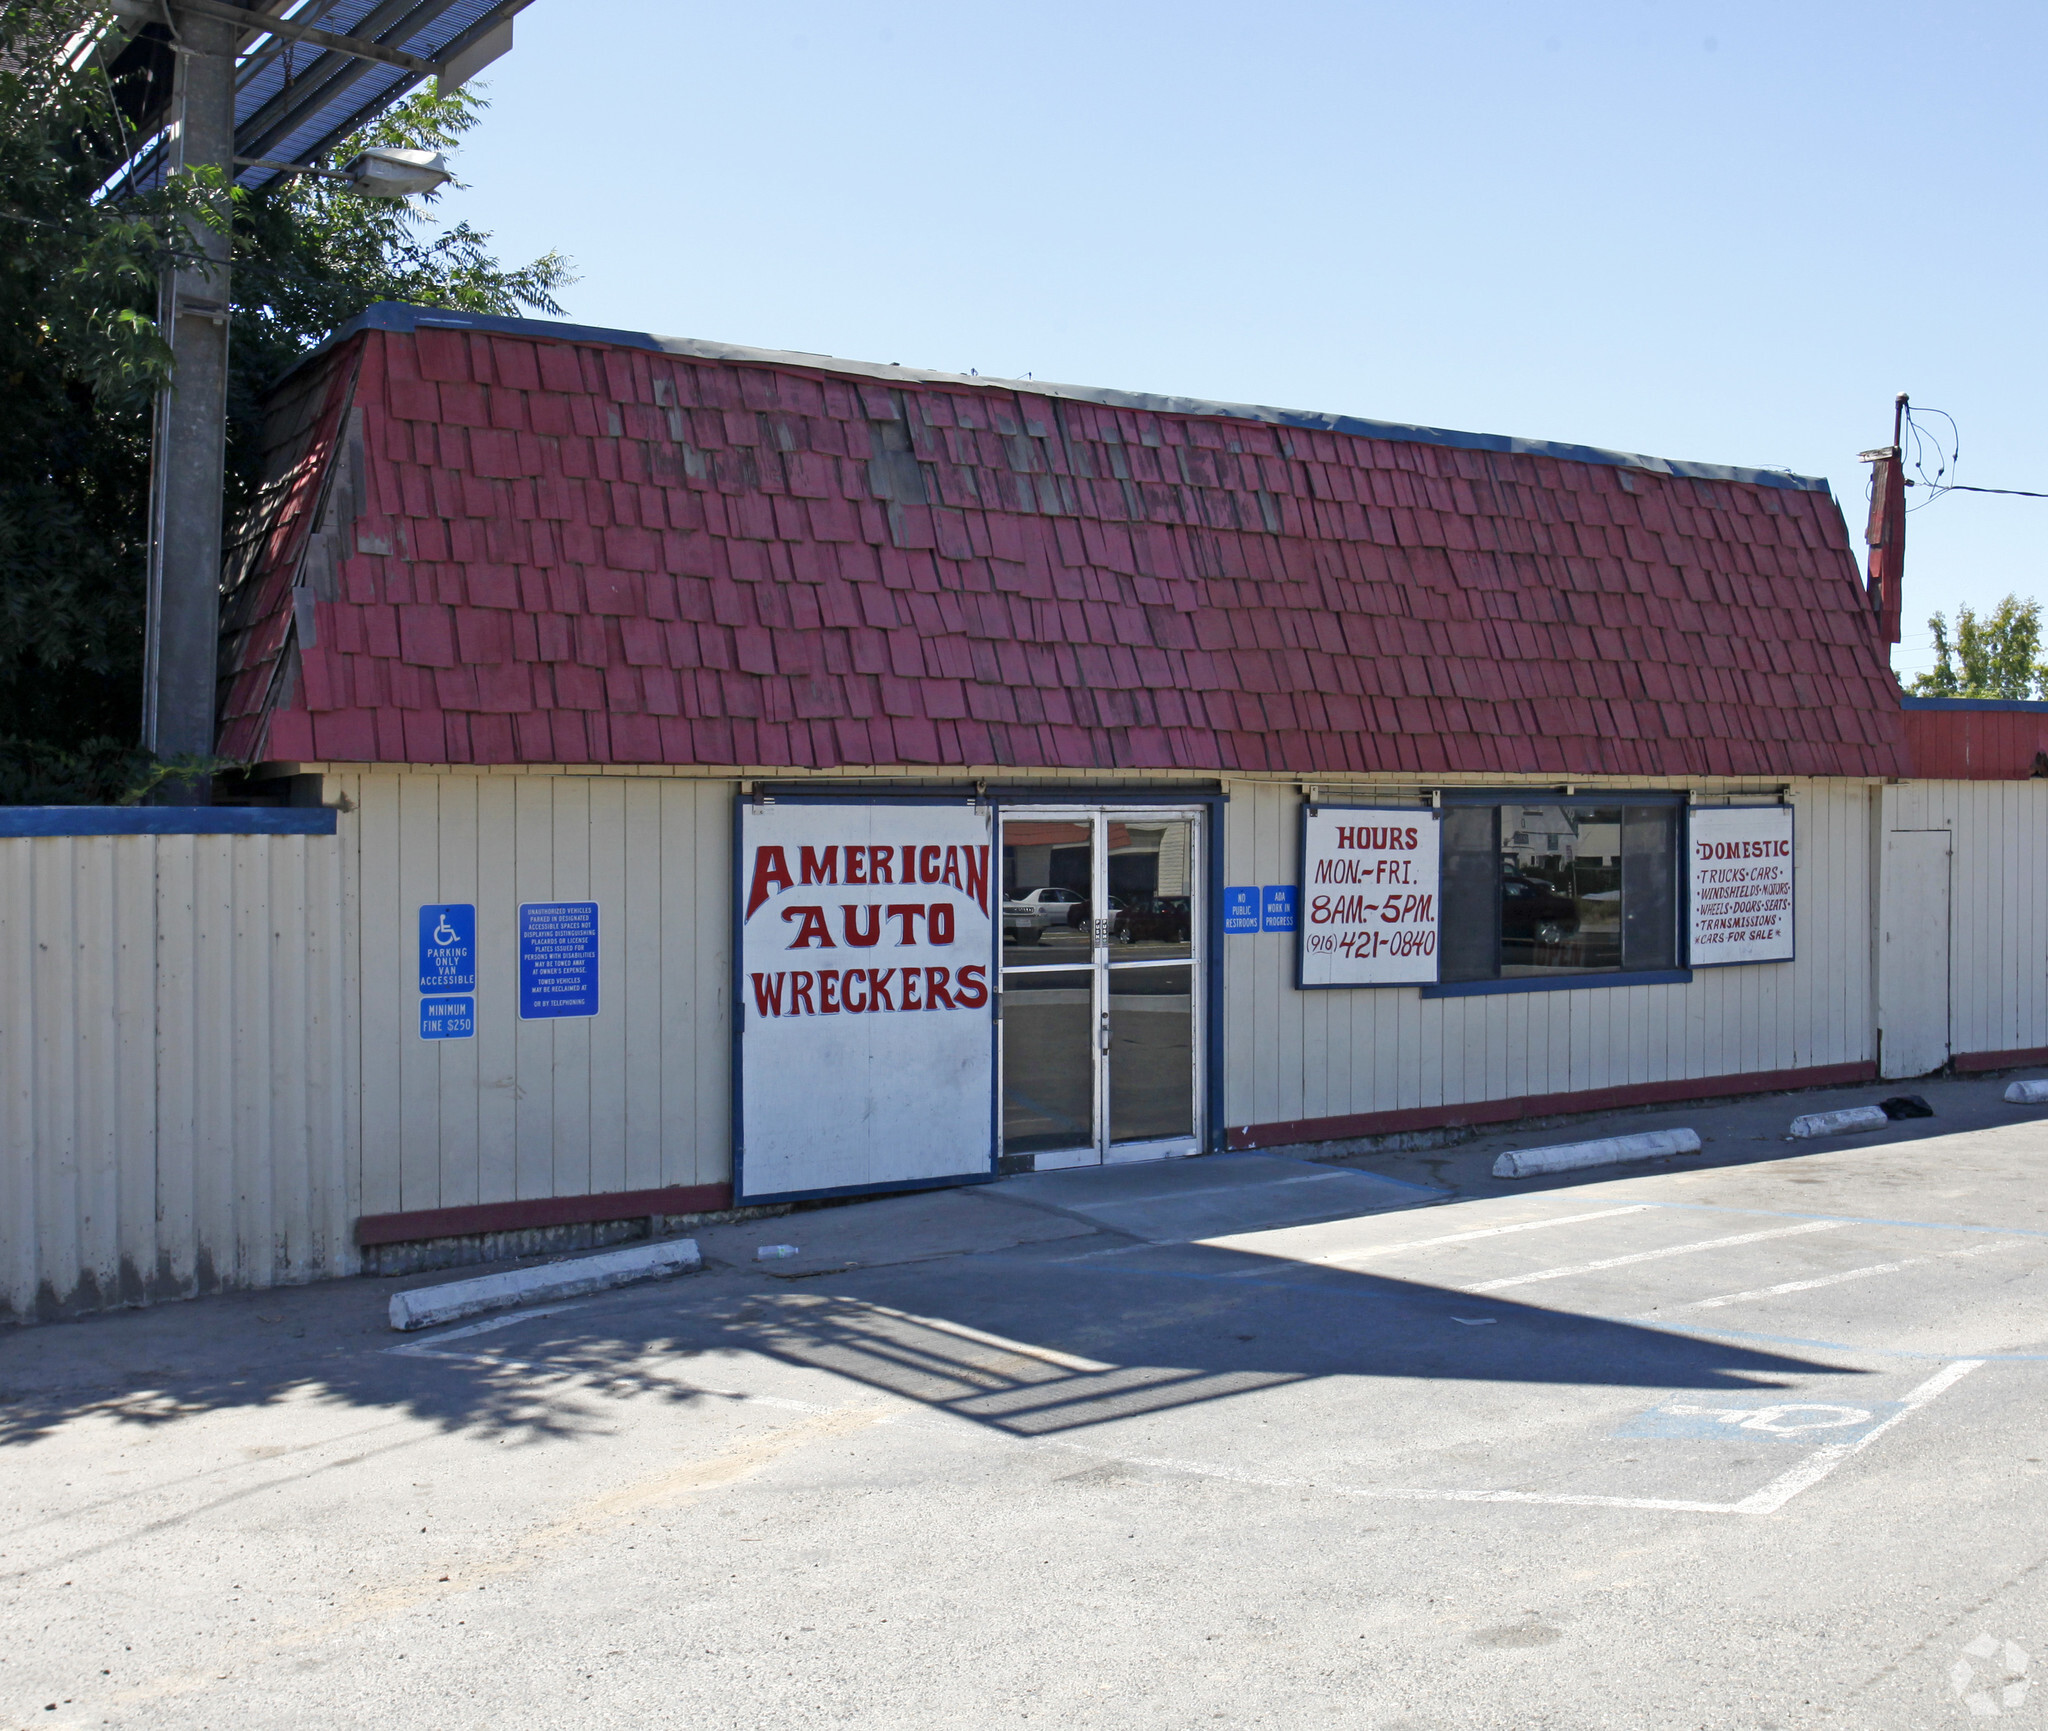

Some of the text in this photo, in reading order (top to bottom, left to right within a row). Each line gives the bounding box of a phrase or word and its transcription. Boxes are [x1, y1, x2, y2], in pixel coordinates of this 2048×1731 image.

[1336, 827, 1418, 850] HOURS
[1697, 840, 1789, 860] DOMESTIC
[1701, 866, 1778, 883] TRUCKS CARS
[744, 845, 990, 925] AMERICAN
[1238, 893, 1246, 903] NO
[1232, 906, 1251, 915] PUBLIC
[1268, 904, 1290, 912] WORK IN
[781, 903, 955, 950] AUTO
[1226, 918, 1257, 928] RESTROOMS
[1266, 917, 1293, 926] PROGRESS
[1701, 915, 1776, 930] TRANSMISSIONS
[1728, 931, 1745, 942] FOR
[1749, 929, 1773, 940] SALE
[1339, 931, 1435, 958] 421-0840
[428, 948, 467, 957] PARKING
[436, 957, 459, 966] ONLY
[439, 967, 455, 975] VAN
[421, 975, 474, 985] ACCESSIBLE
[747, 965, 988, 1017] WRECKERS
[429, 1004, 465, 1016] MINIMUM
[424, 1020, 442, 1031] FINE
